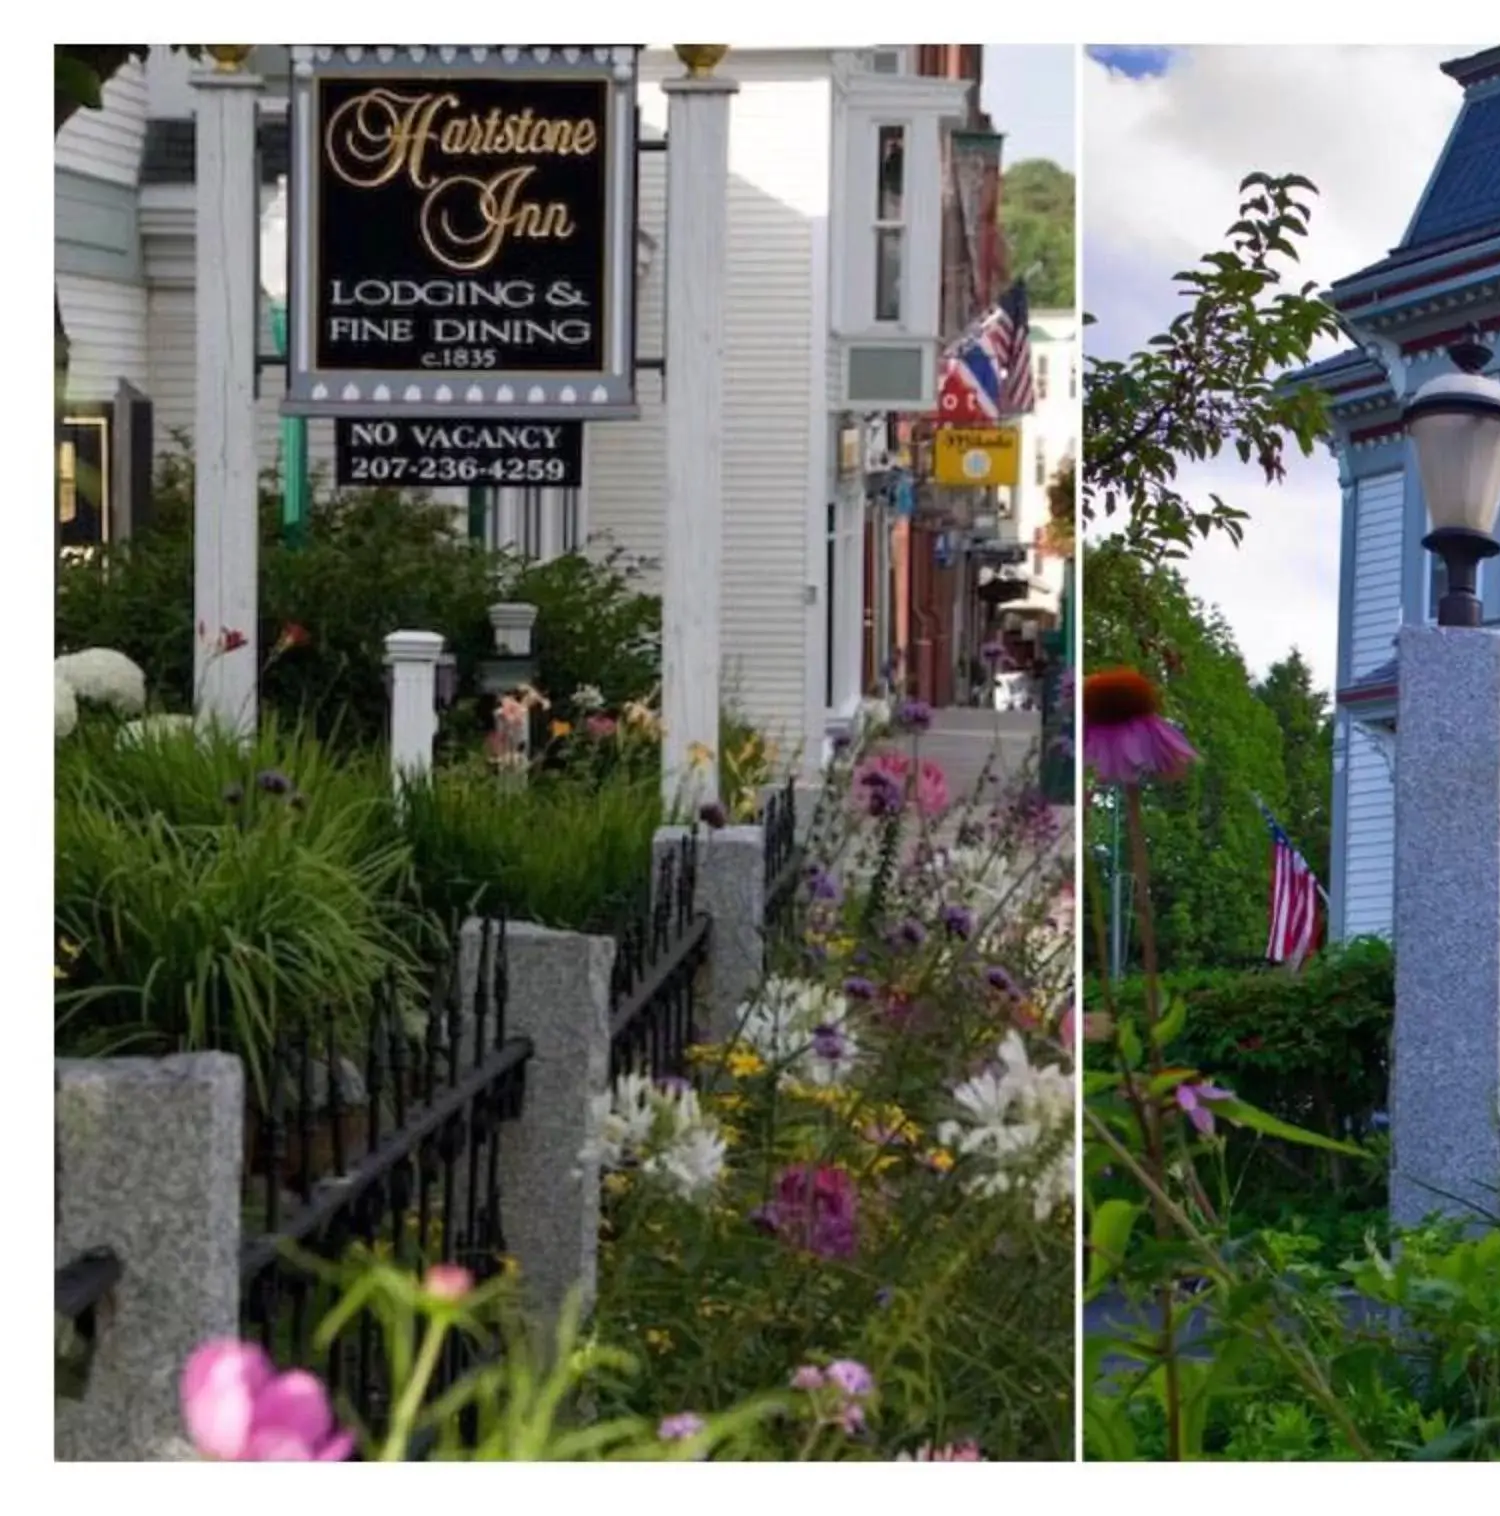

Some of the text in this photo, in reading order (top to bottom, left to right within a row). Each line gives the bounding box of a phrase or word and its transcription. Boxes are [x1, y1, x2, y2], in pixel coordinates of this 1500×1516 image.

[327, 88, 597, 189] Hartstone
[420, 166, 575, 269] Inn
[331, 279, 591, 308] LODGING &
[329, 317, 591, 345] FINE DINING
[421, 348, 497, 368] c.1835
[351, 423, 562, 449] NO VACANCY
[351, 457, 565, 481] 207-236-4259
